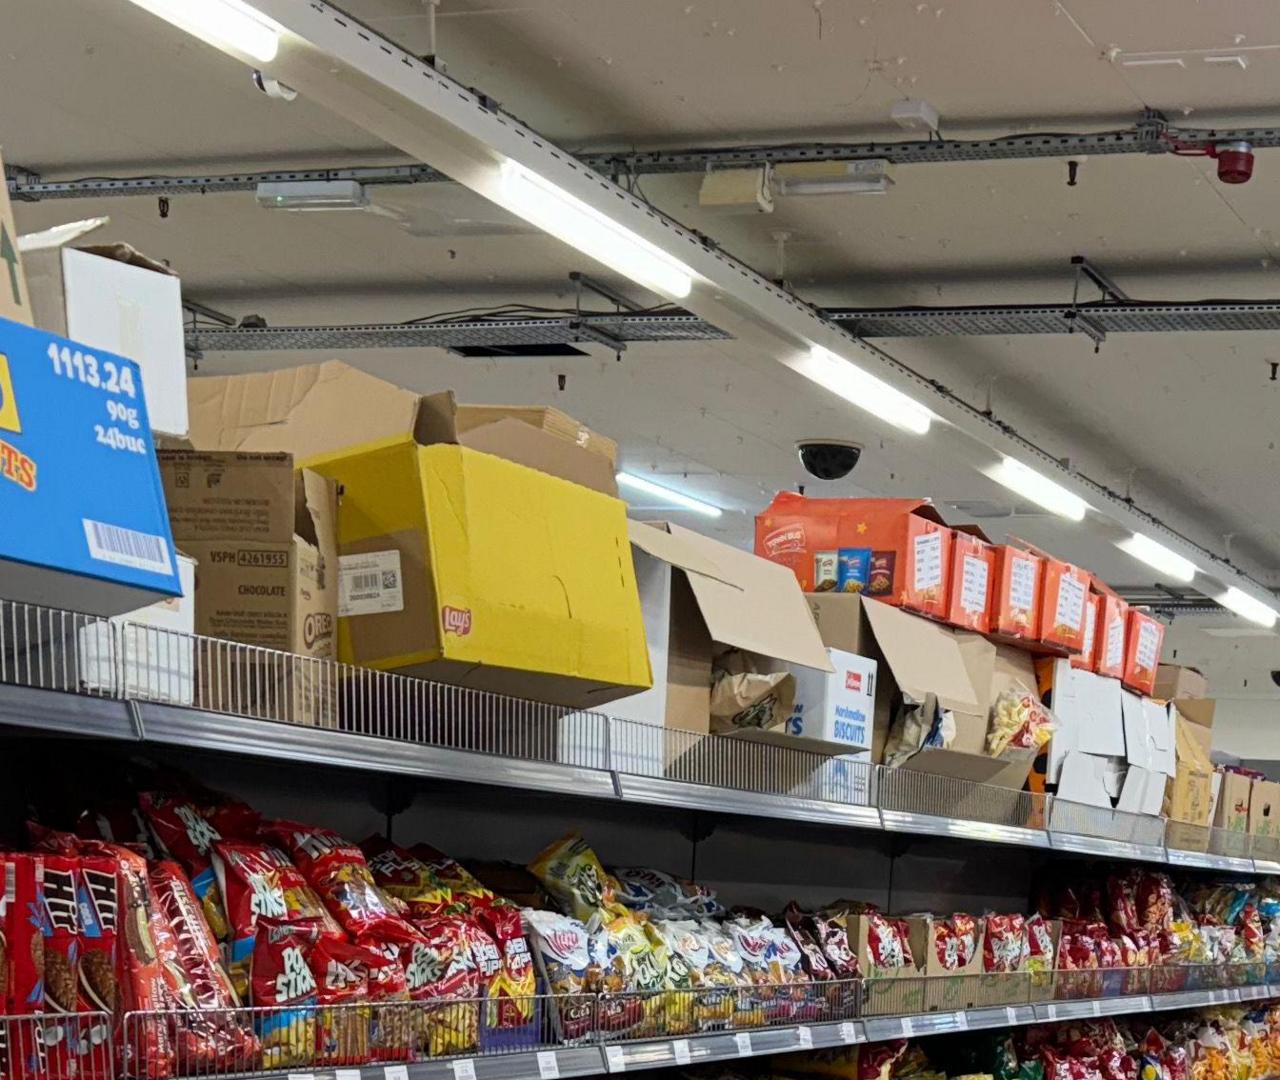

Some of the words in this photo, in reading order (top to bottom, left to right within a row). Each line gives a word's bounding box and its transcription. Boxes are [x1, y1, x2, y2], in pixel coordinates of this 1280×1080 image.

[47, 342, 137, 399] 1113.24
[106, 400, 140, 430] 90g
[94, 424, 147, 455] 24buc
[210, 551, 236, 564] VSPH
[239, 551, 285, 565] 4261955
[237, 585, 287, 597] CHOCOLATE
[303, 612, 333, 650] OREO
[442, 608, 472, 632] Lay's
[833, 719, 866, 745] BISCUITS
